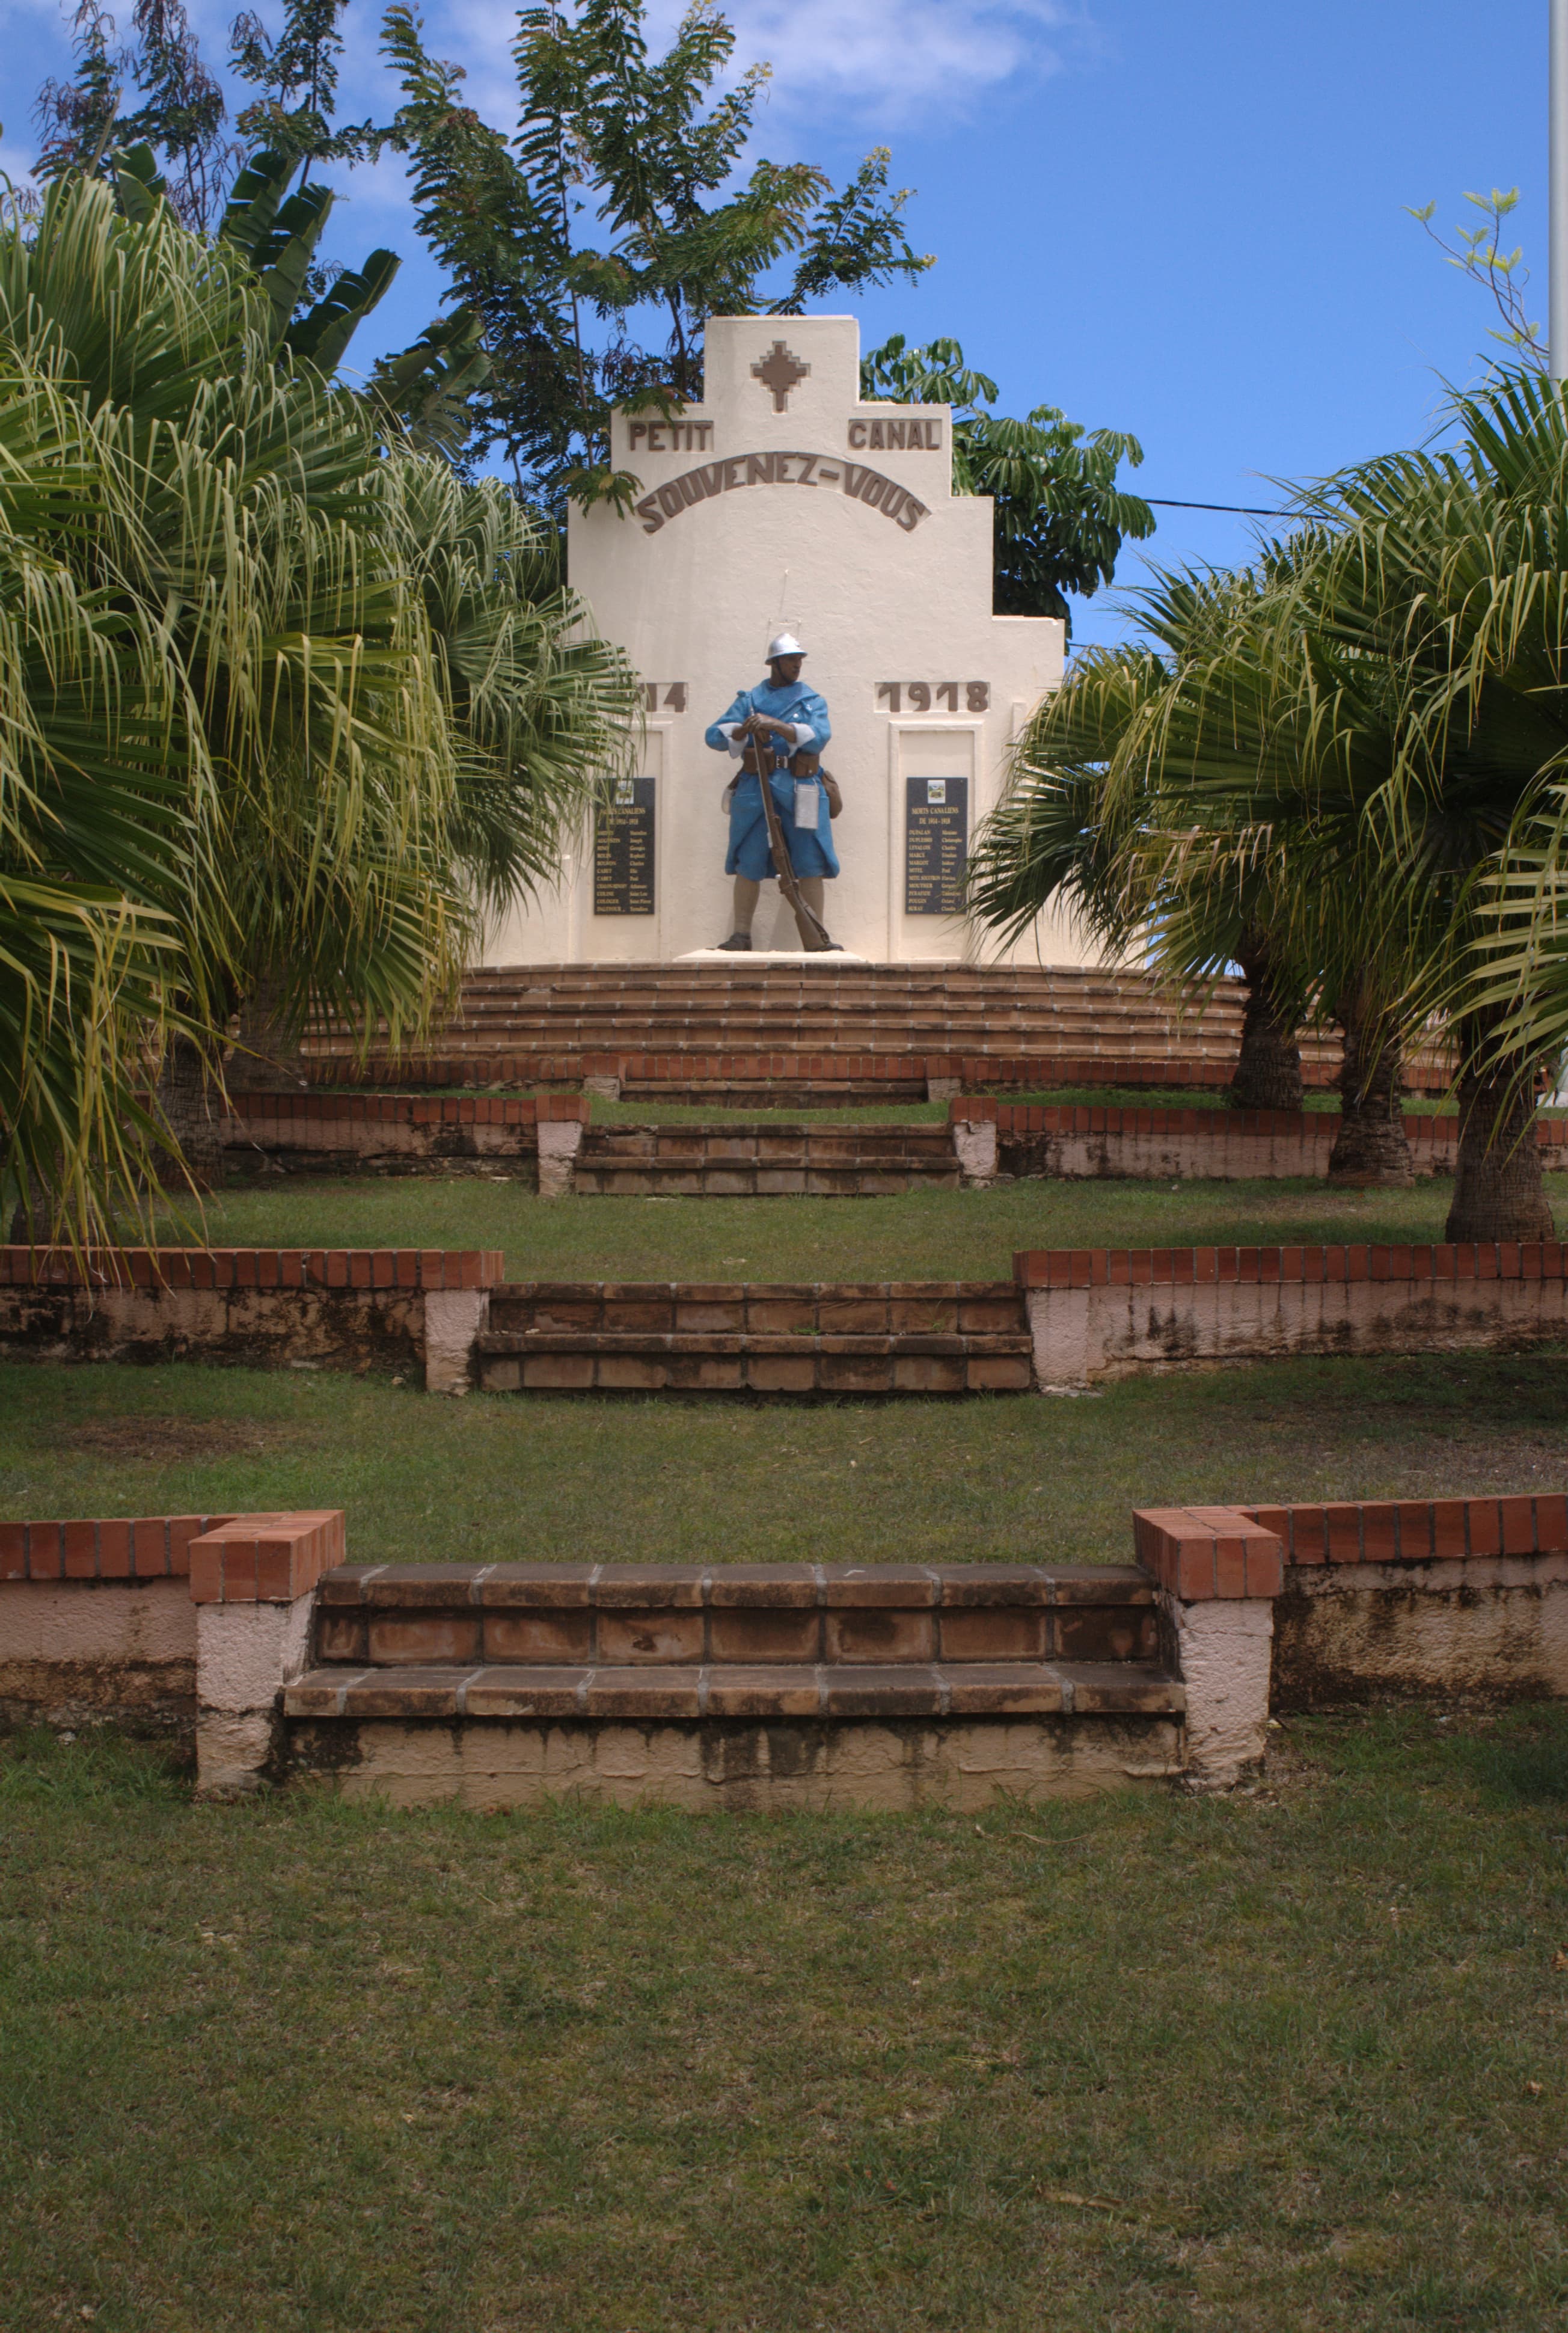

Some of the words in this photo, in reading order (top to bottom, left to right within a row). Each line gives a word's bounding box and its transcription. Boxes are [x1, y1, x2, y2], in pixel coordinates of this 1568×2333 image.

[629, 423, 712, 451] PETIT
[848, 422, 940, 450] CANAL
[637, 452, 925, 533] SOUVENEZ-VOUS
[878, 681, 988, 713] 1918
